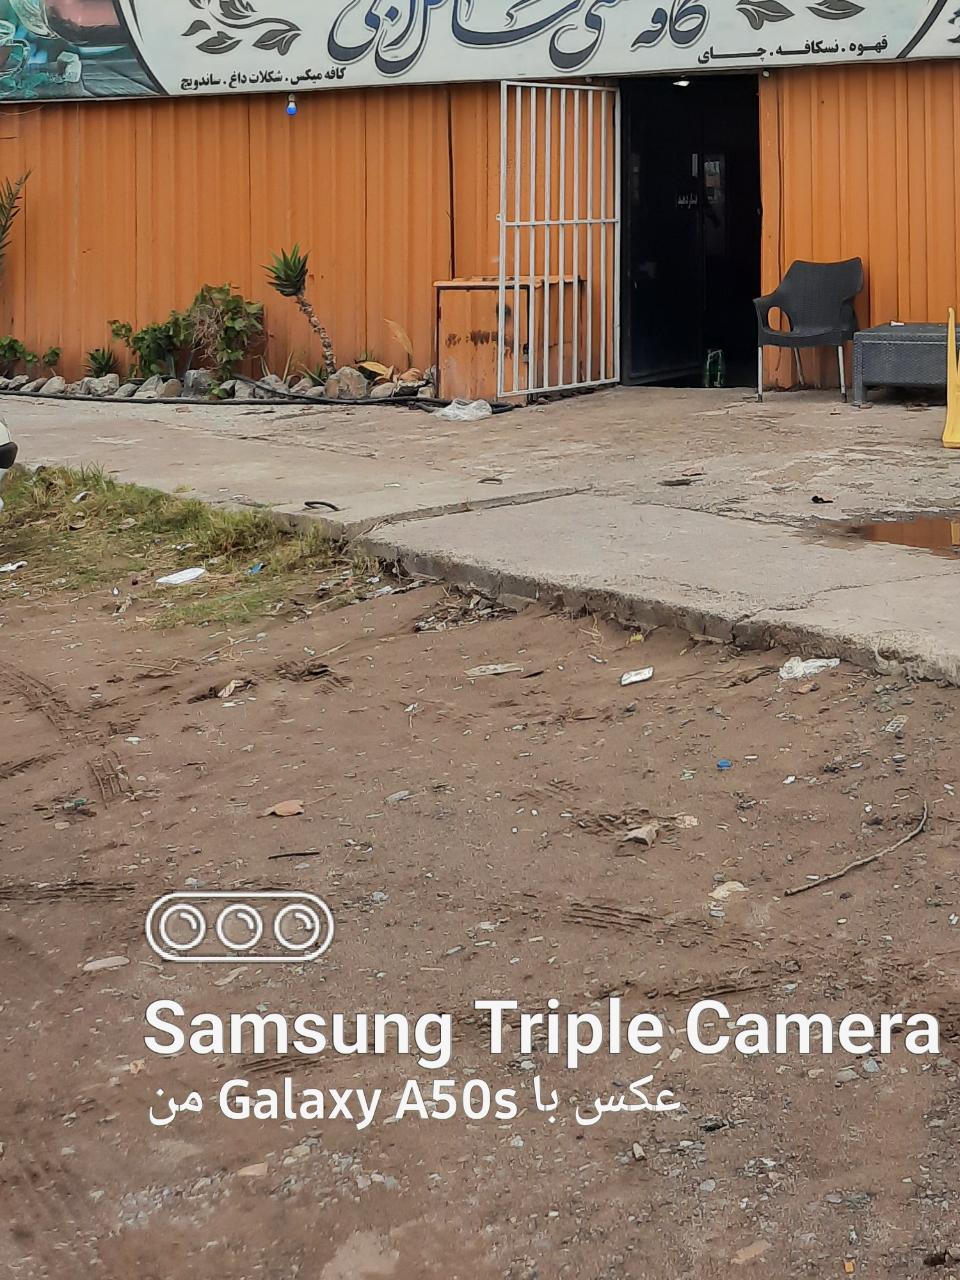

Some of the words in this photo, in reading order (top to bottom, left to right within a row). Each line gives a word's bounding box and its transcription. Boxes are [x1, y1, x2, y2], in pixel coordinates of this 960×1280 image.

[775, 39, 839, 55] نسکافه
[849, 35, 888, 56] قهوه
[697, 46, 767, 64] چای
[180, 73, 221, 91] ساندویچ
[228, 70, 247, 89] داغ
[248, 70, 283, 84] شکلات
[290, 68, 322, 86] میکس
[324, 66, 347, 80] کافه
